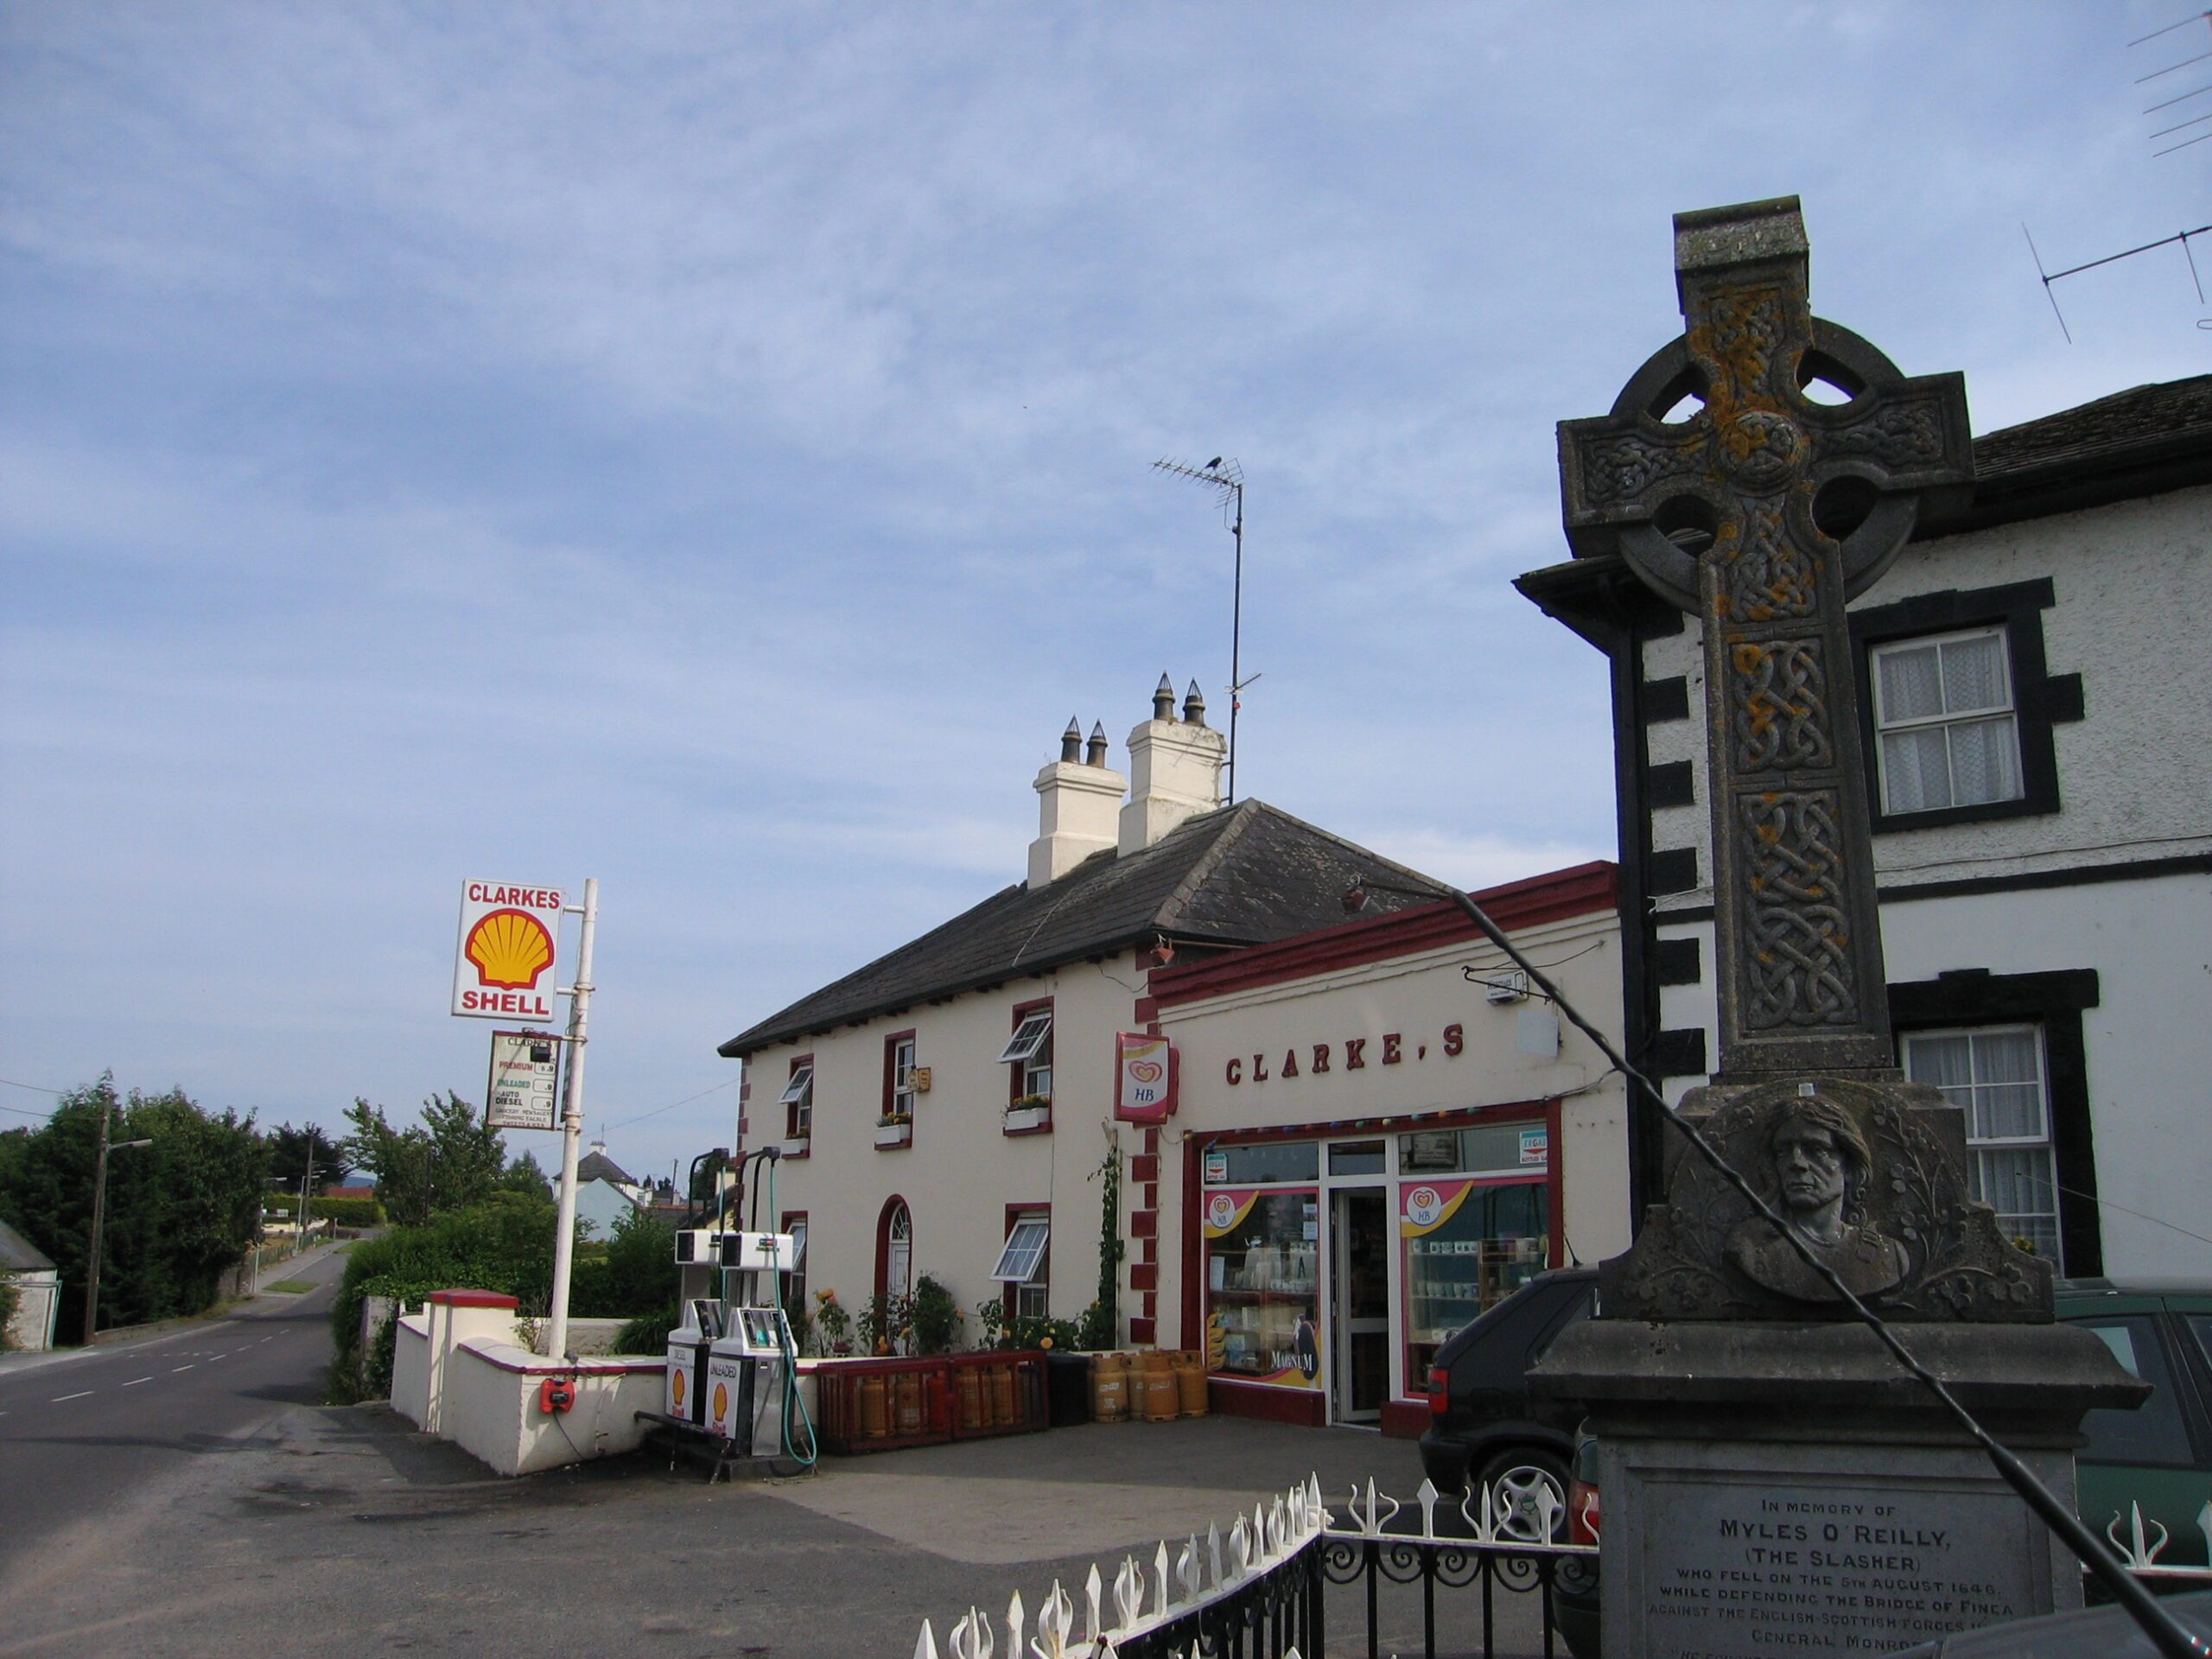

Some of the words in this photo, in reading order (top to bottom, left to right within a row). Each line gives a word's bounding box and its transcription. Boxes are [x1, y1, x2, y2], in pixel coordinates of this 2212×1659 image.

[469, 884, 560, 909] CLARKES
[461, 990, 549, 1015] SHELL
[499, 1061, 533, 1071] PREMIUM
[497, 1078, 531, 1089] UNLEADED
[495, 1097, 523, 1106] DIESEL
[1135, 1088, 1154, 1102] HB
[1217, 1215, 1227, 1225] HB
[1418, 1211, 1431, 1222] HB
[710, 1363, 737, 1379] UNLEADED
[1677, 1568, 1712, 1580] WHO
[1720, 1571, 1763, 1583] FELL
[1770, 1573, 1791, 1584] ON
[1800, 1574, 1833, 1586] THE
[1872, 1579, 1943, 1592] AUGUST
[1659, 1586, 1711, 1598] WHILE
[1718, 1589, 1819, 1605] DEFENDING
[1826, 1595, 1858, 1606] THE
[1932, 1600, 1953, 1612] OF
[1649, 1604, 1710, 1618] AGAINST
[1718, 1607, 1745, 1618] THE
[1901, 1615, 1964, 1632] FORCES
